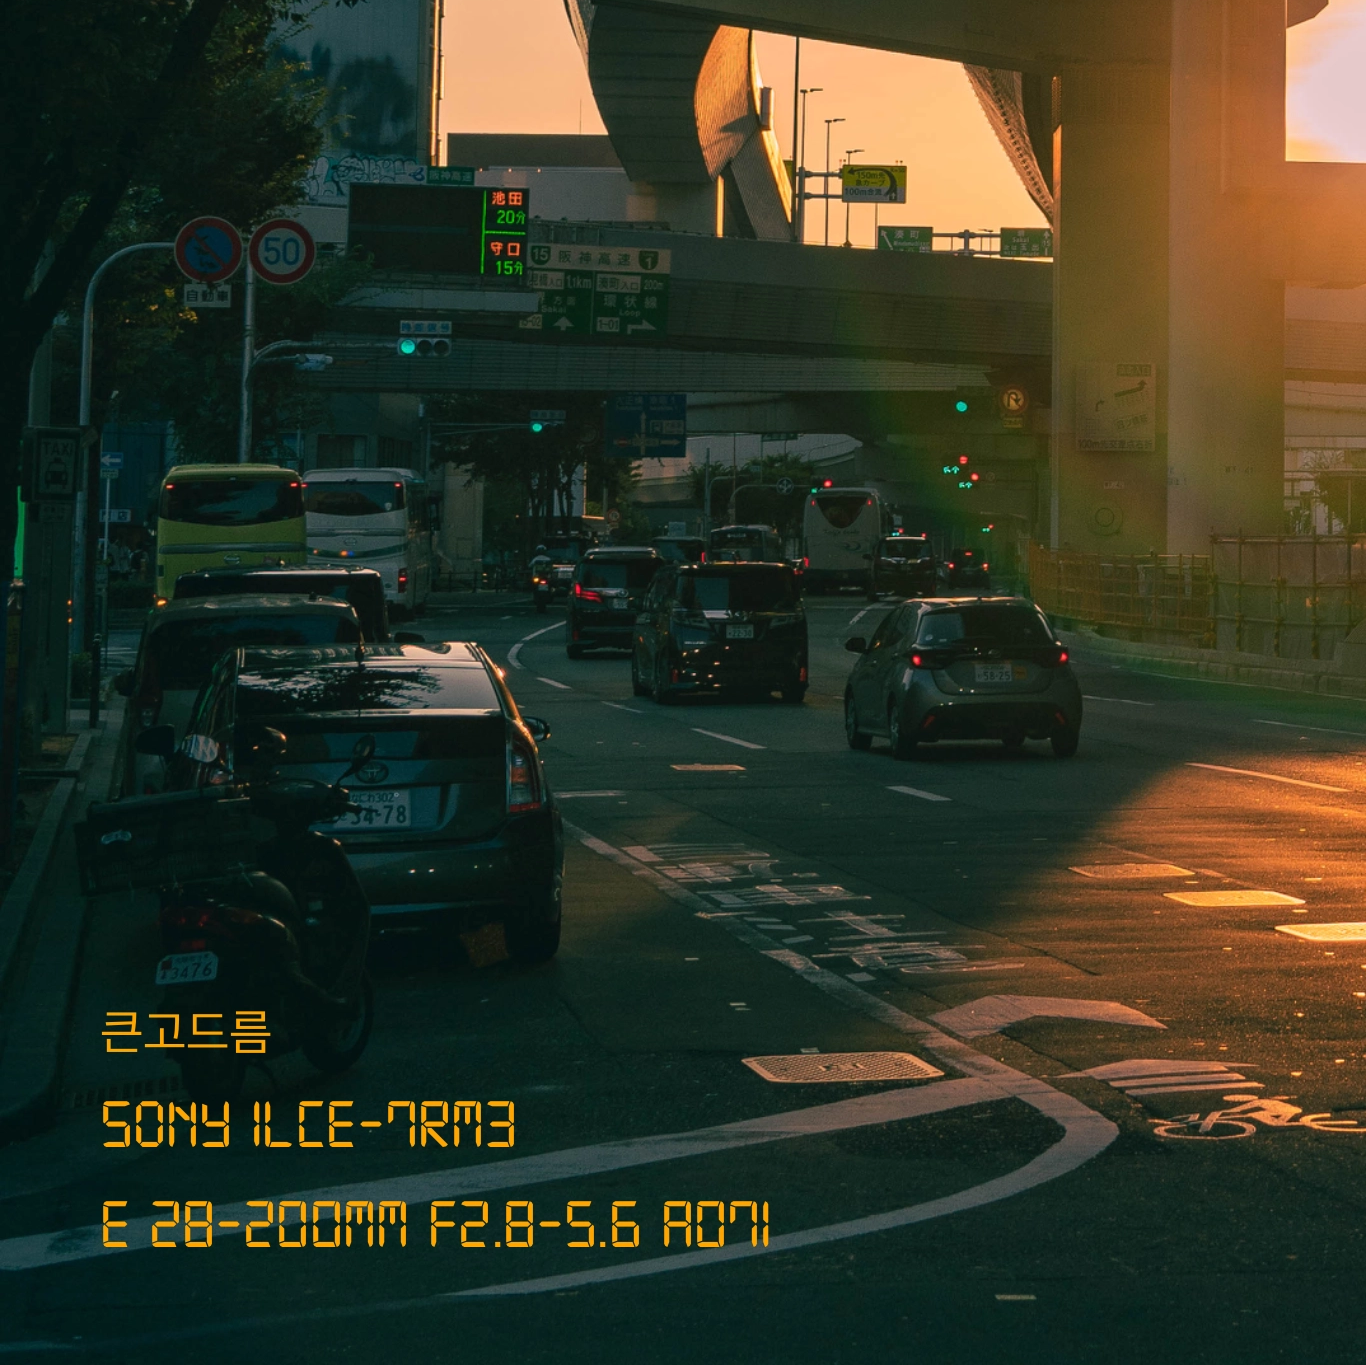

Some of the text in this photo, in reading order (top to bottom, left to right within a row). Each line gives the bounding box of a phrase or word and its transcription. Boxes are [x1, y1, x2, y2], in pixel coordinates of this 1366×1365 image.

[492, 191, 523, 206] 池田
[496, 209, 526, 225] 20分
[264, 237, 300, 265] 50
[490, 241, 521, 256] 守口
[533, 248, 549, 260] 15
[558, 250, 631, 267] 阪神高速
[645, 257, 652, 269] 1
[495, 260, 524, 276] 15分
[186, 289, 229, 302] 自動車
[604, 294, 658, 309] 環状線
[619, 309, 641, 317] Loop
[599, 319, 619, 330] 1-01
[43, 442, 72, 456] TAXI
[170, 961, 212, 980] 3476
